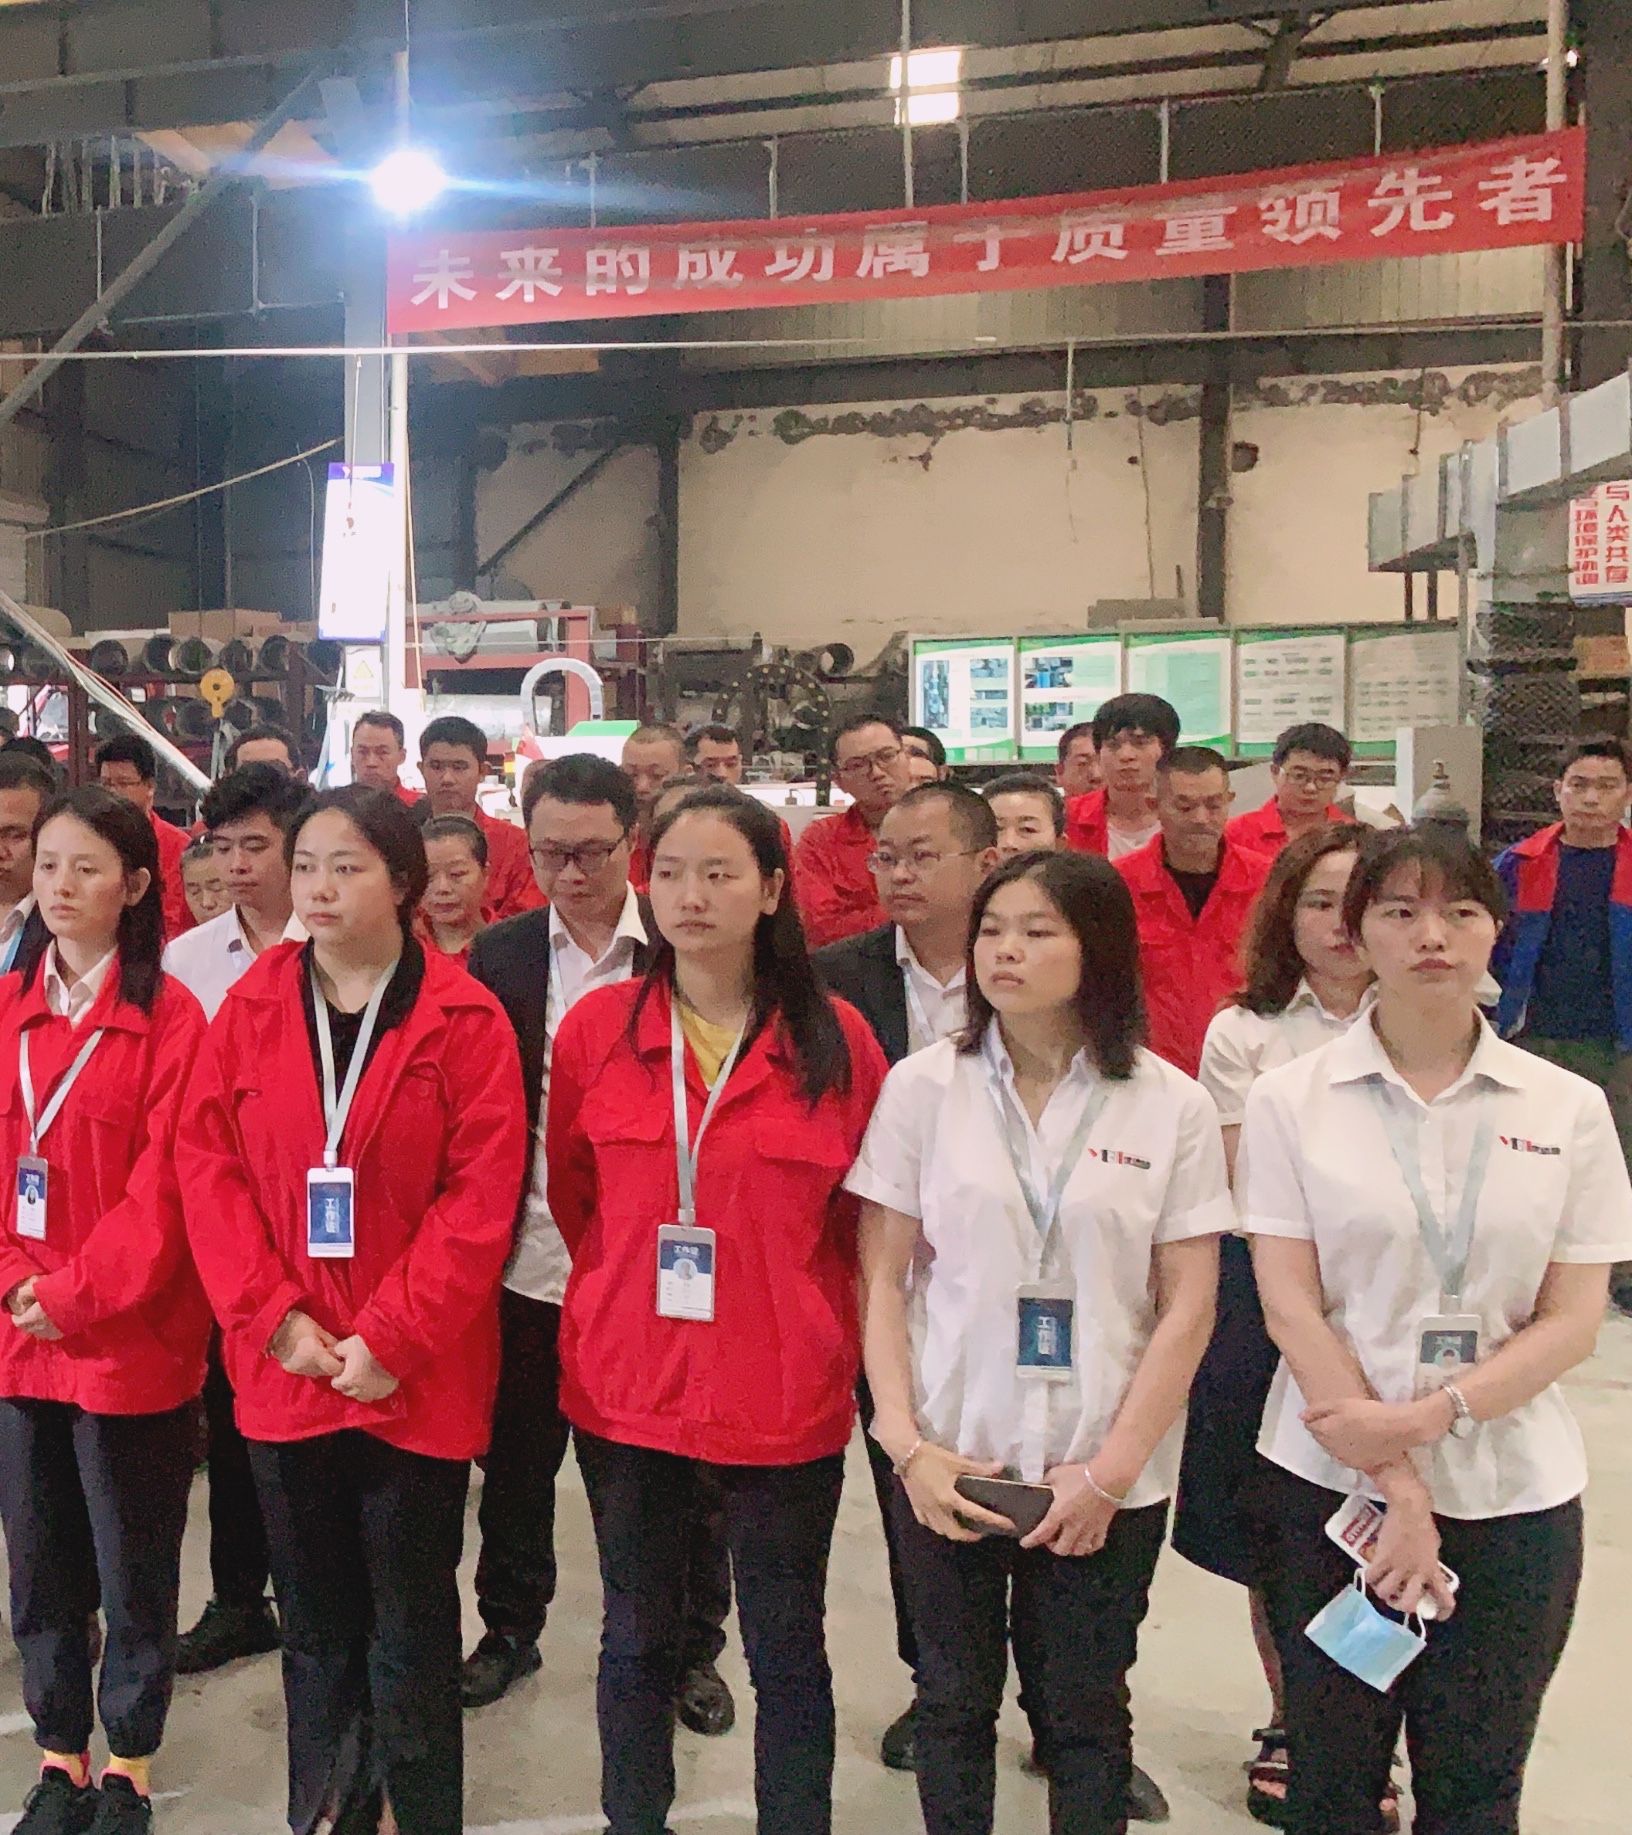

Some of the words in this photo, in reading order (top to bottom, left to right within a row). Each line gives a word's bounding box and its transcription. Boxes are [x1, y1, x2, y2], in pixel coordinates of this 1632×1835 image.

[410, 155, 1567, 311] 未来的成功属于质量领先者
